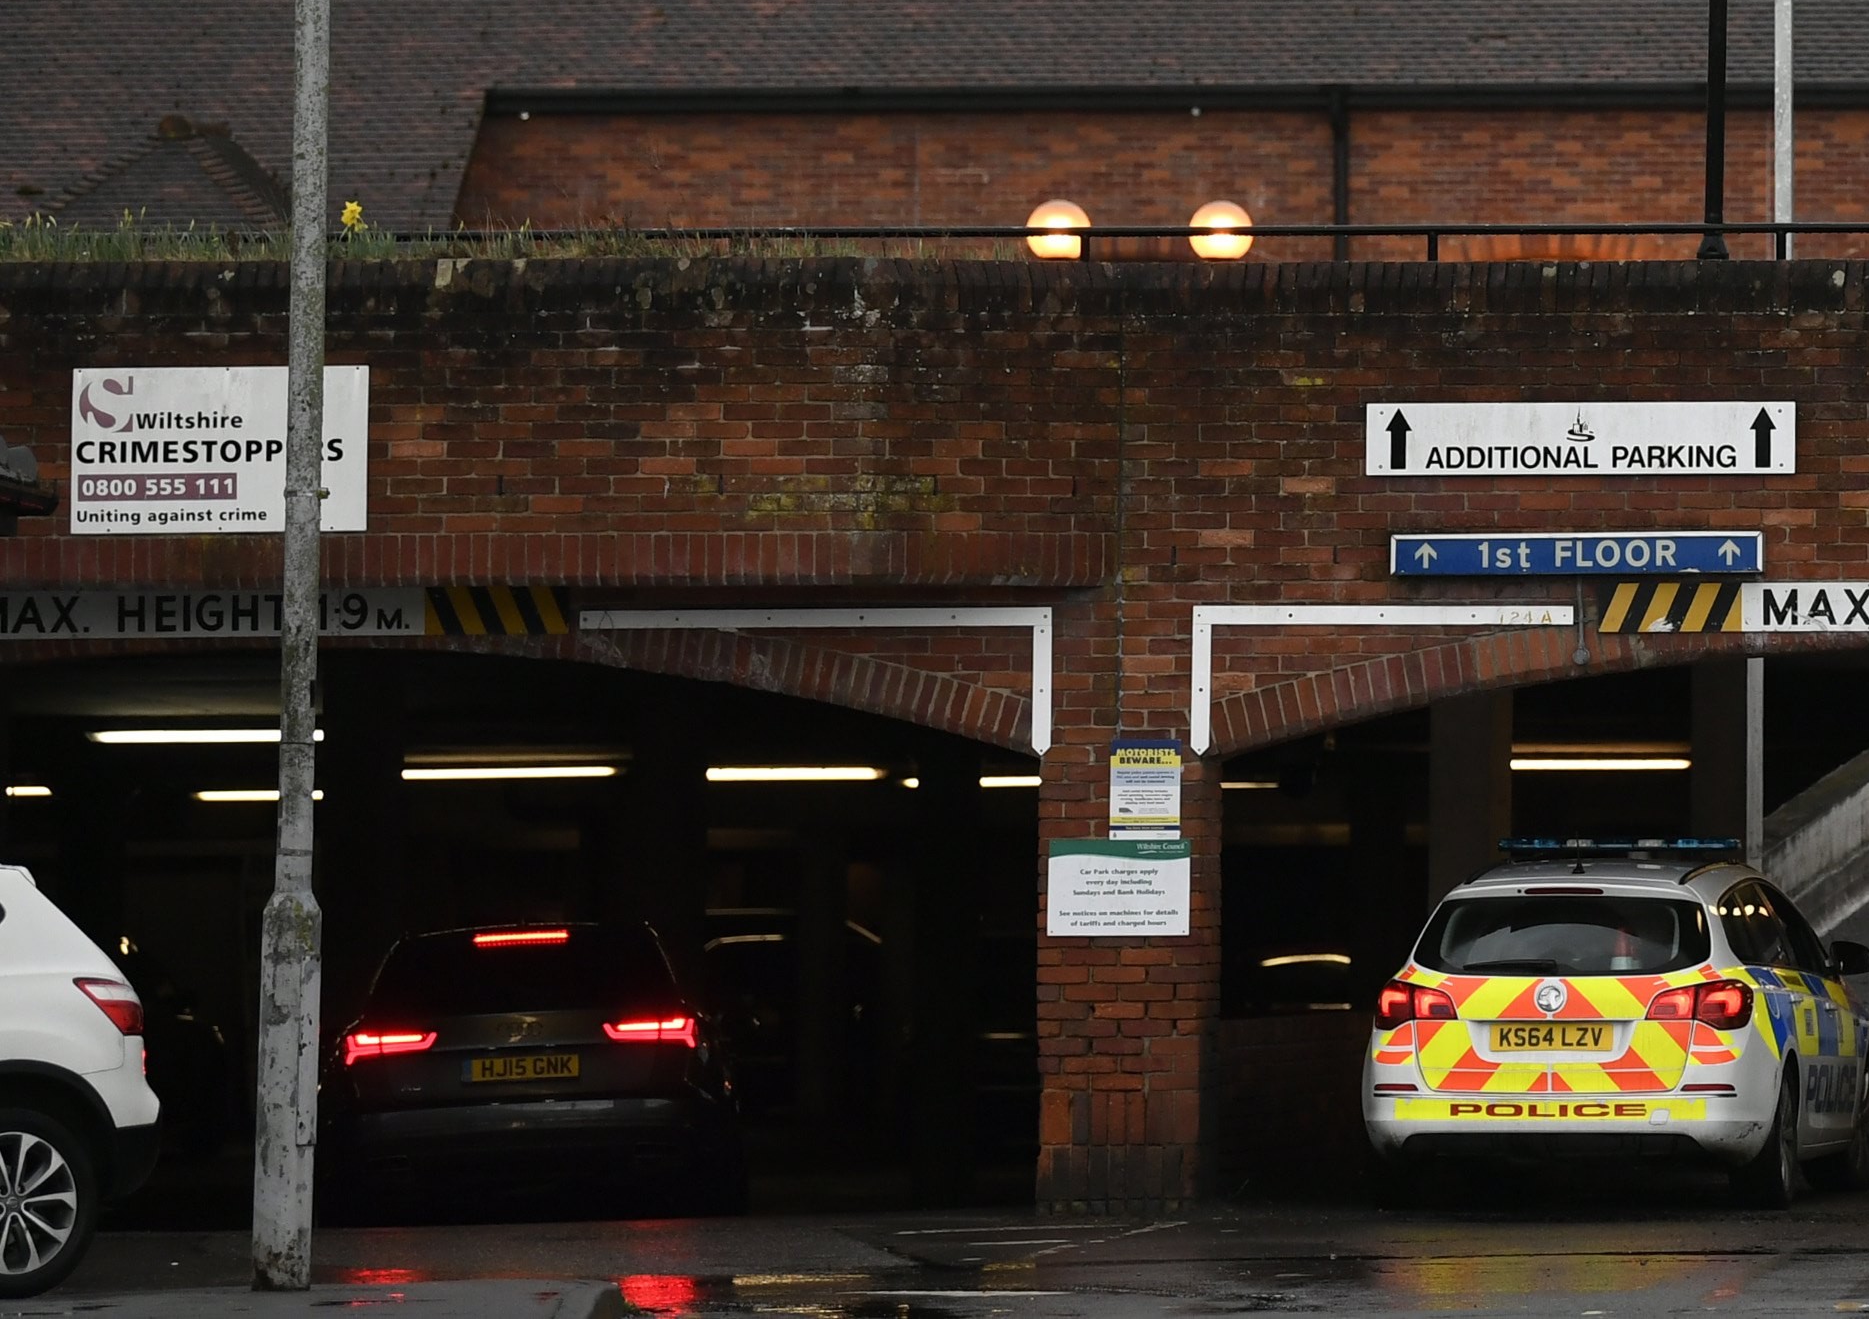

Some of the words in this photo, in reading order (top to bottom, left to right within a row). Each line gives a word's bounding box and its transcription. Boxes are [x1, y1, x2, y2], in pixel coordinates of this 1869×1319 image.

[136, 411, 243, 430] Wiltshire
[76, 438, 344, 464] CRIMESTOPPS
[1425, 446, 1598, 470] ADDITIONAL
[1611, 445, 1737, 469] PARKING
[82, 479, 137, 496] 0800
[146, 479, 186, 496] 555
[196, 478, 233, 495] 111
[77, 510, 141, 525] Uniting
[148, 509, 213, 525] against
[219, 509, 267, 522] crime
[1478, 541, 1530, 570] 1st
[1554, 540, 1677, 568] FLOOR
[117, 594, 283, 633] HEIGHT
[1116, 749, 1176, 757] MOTORISTS
[1111, 869, 1138, 877] charges
[1498, 1026, 1555, 1049] KS64
[1561, 1026, 1603, 1048] LZV
[481, 1058, 527, 1078] HJ15
[533, 1056, 572, 1076] GNK
[1449, 1104, 1646, 1118] POLICE
